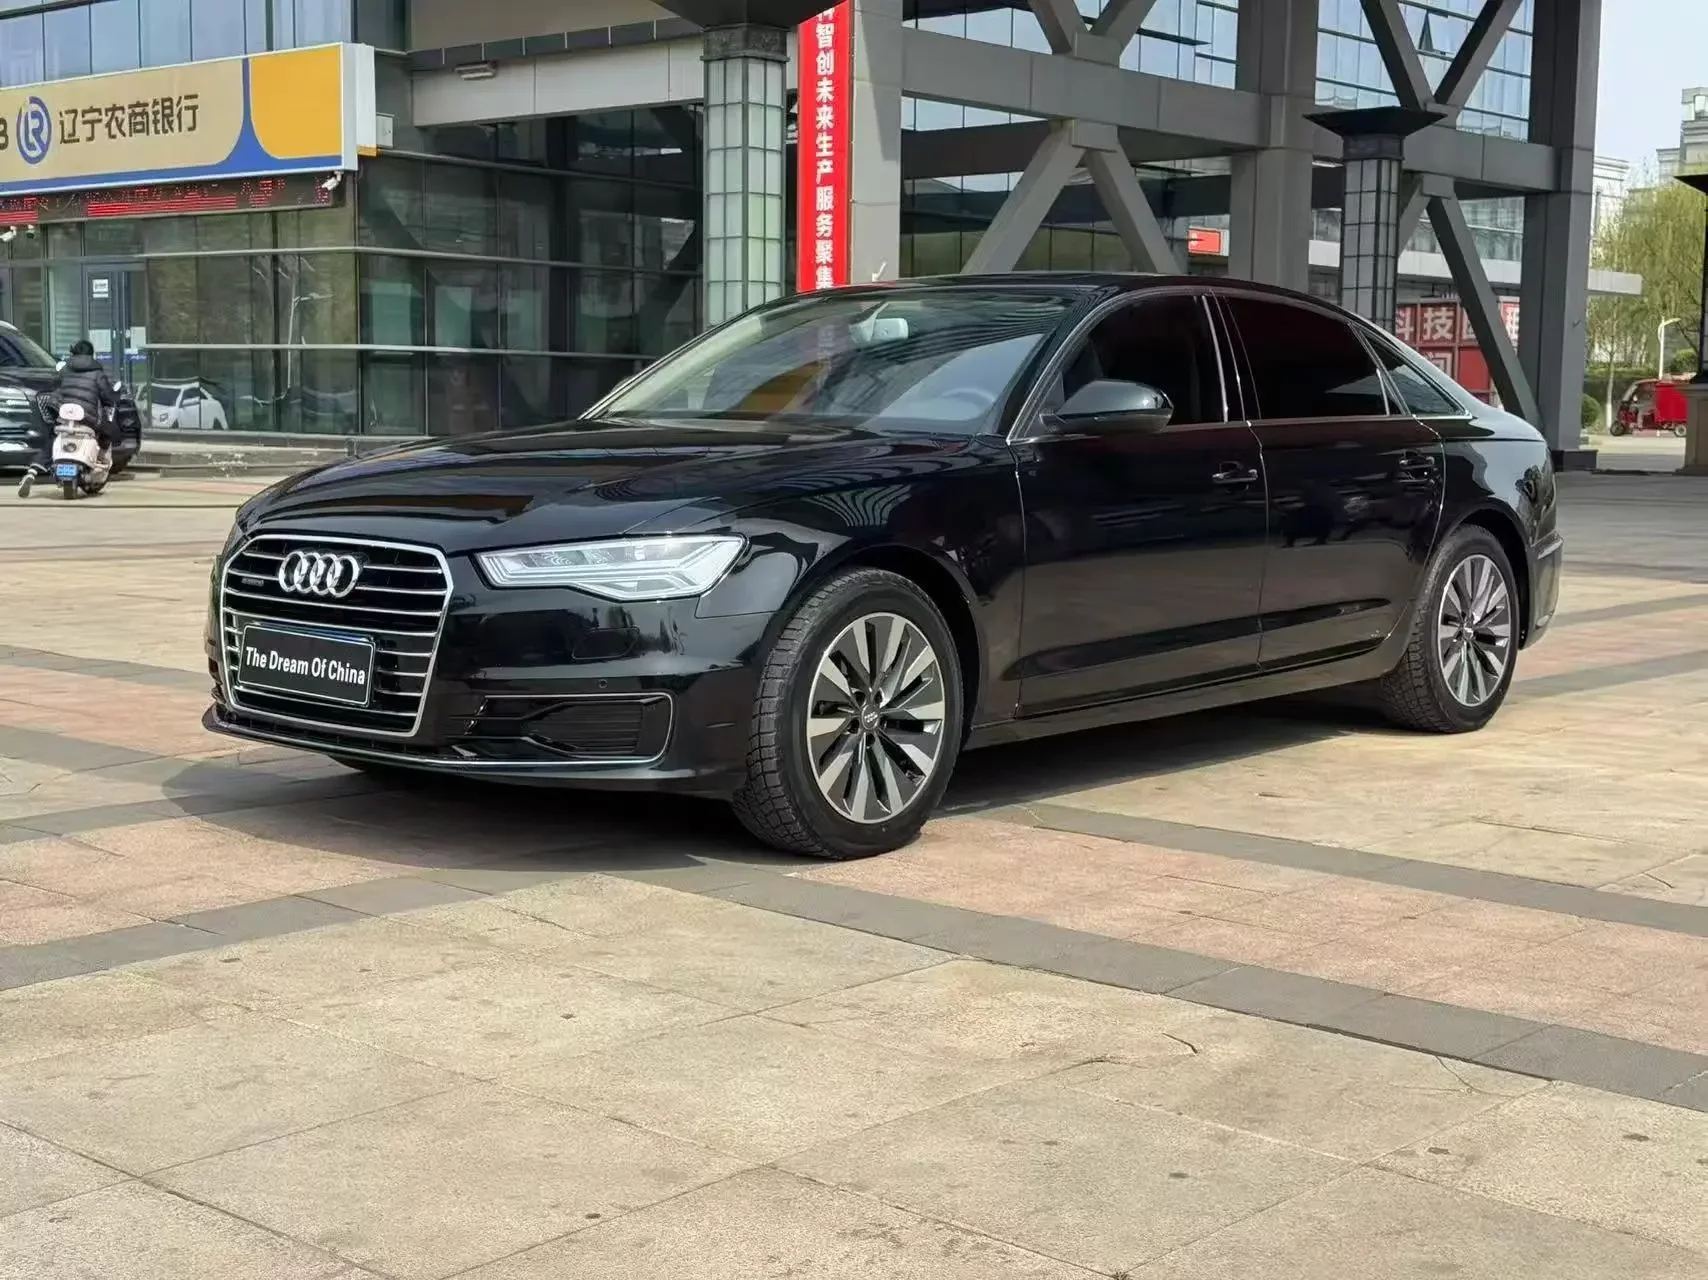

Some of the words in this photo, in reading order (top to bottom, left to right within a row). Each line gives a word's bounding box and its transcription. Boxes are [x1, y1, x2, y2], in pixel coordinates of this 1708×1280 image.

[59, 94, 199, 145] 辽宁农商银行
[246, 647, 267, 668] The
[269, 650, 309, 676] Dream
[311, 657, 326, 679] Of
[328, 660, 366, 685] China
